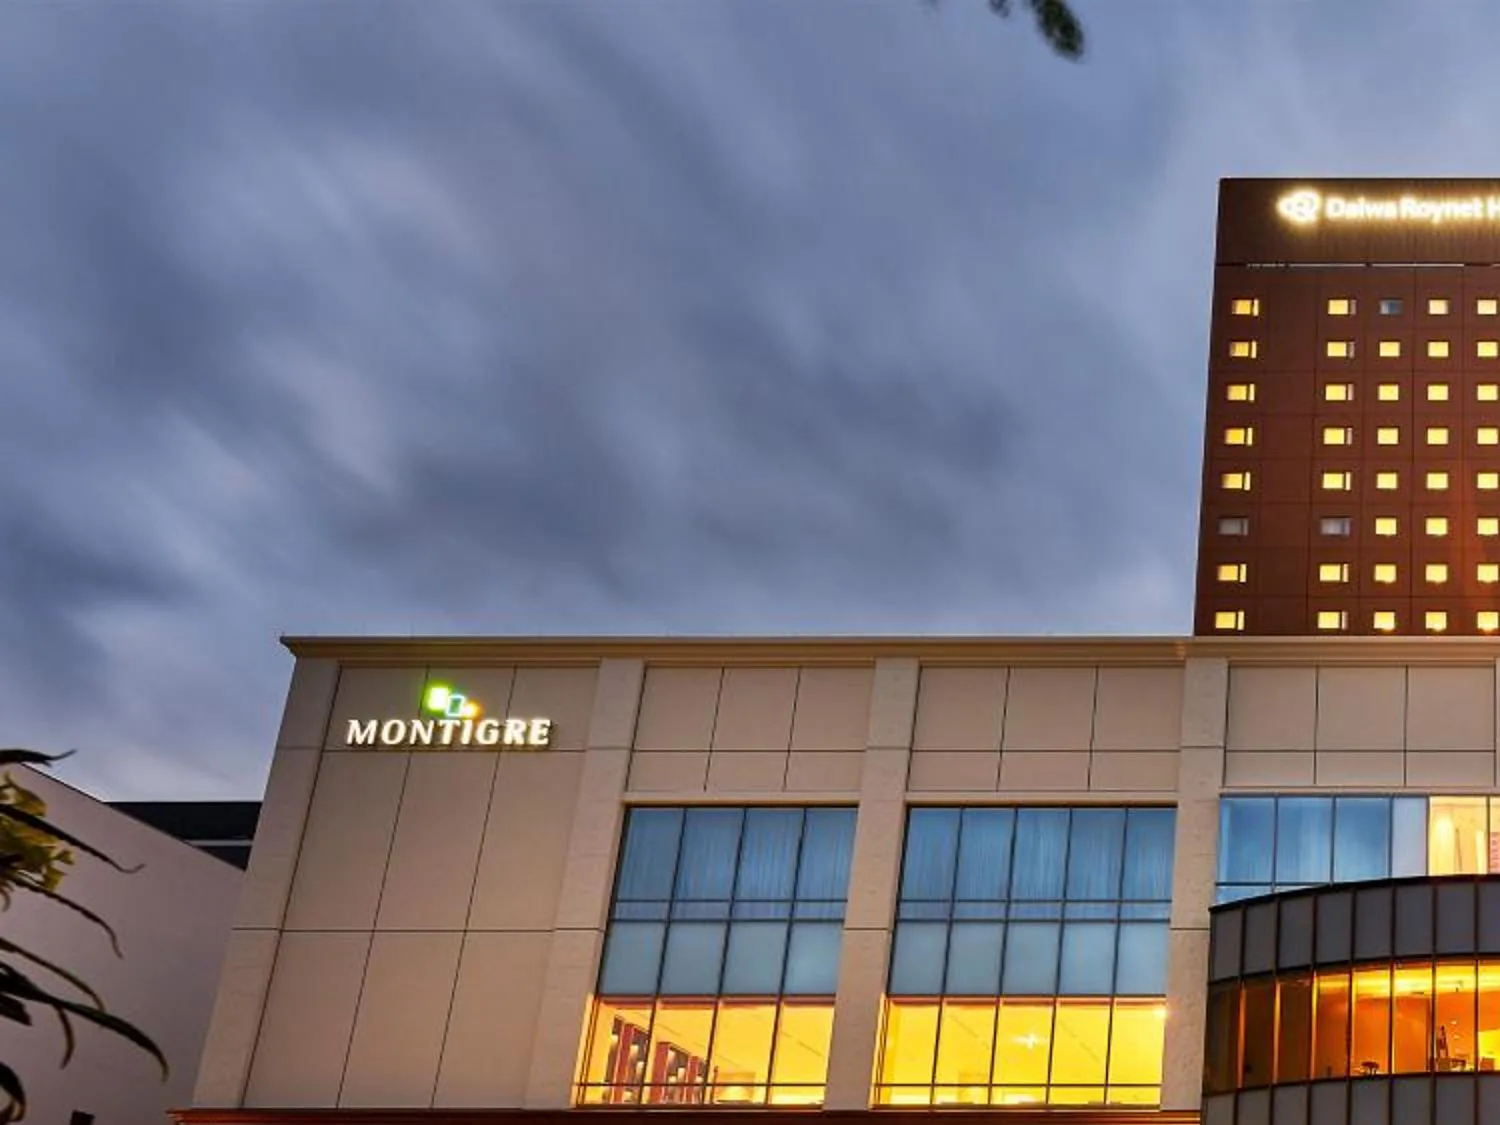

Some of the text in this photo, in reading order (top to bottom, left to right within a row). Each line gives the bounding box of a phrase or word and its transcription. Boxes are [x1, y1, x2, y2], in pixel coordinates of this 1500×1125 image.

[1325, 196, 1398, 219] Daiwa
[1400, 196, 1482, 224] Roynet
[346, 718, 551, 746] MONTIGRE
